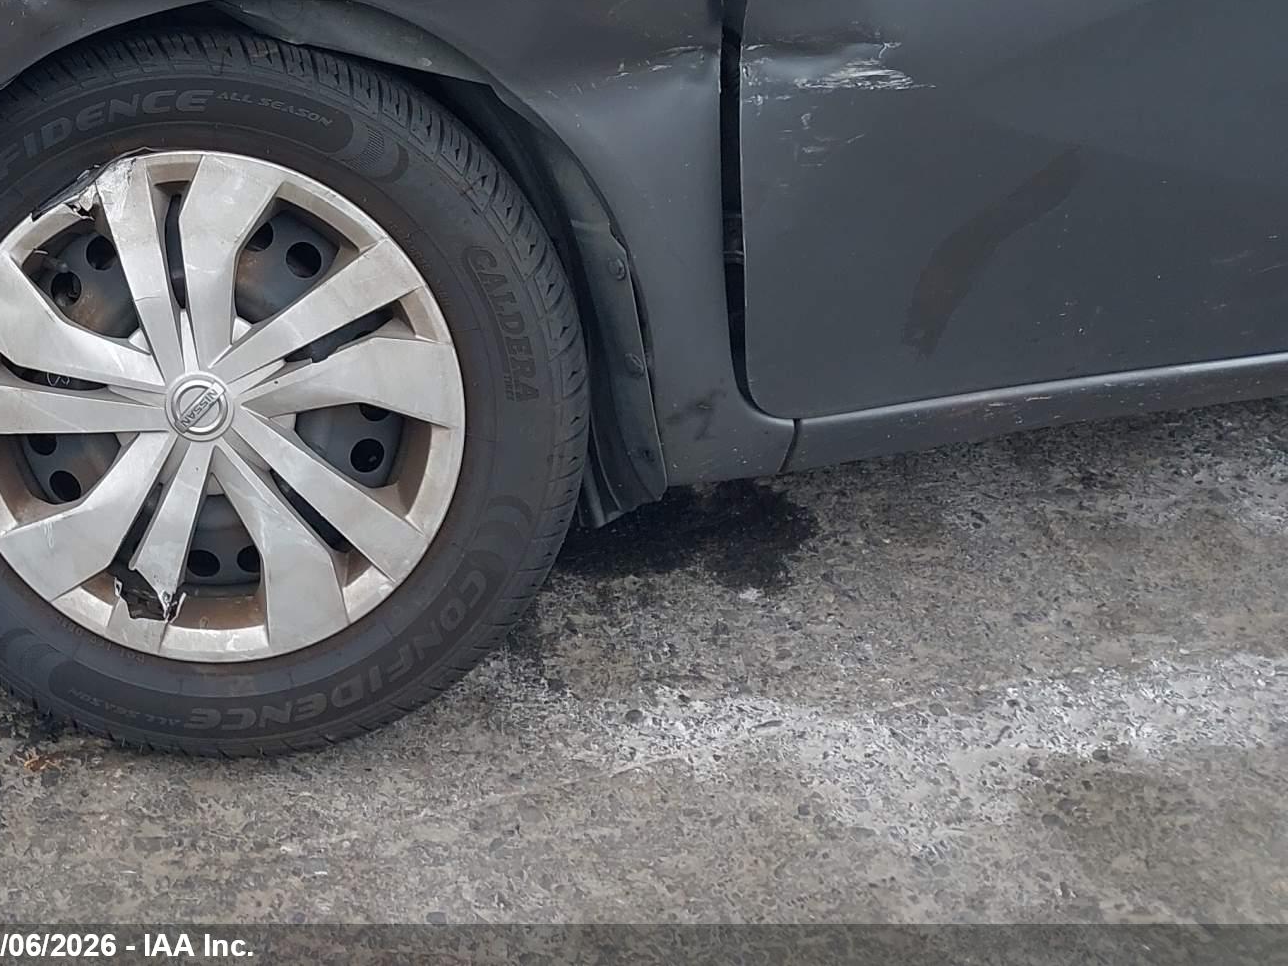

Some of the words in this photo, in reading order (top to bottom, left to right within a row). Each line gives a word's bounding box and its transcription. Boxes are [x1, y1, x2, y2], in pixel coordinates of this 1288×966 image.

[215, 90, 254, 107] ALL
[257, 97, 335, 127] SEASON
[471, 248, 539, 402] CALDERA
[180, 388, 219, 428] NISSAN
[183, 569, 488, 731] CONFIDENCE
